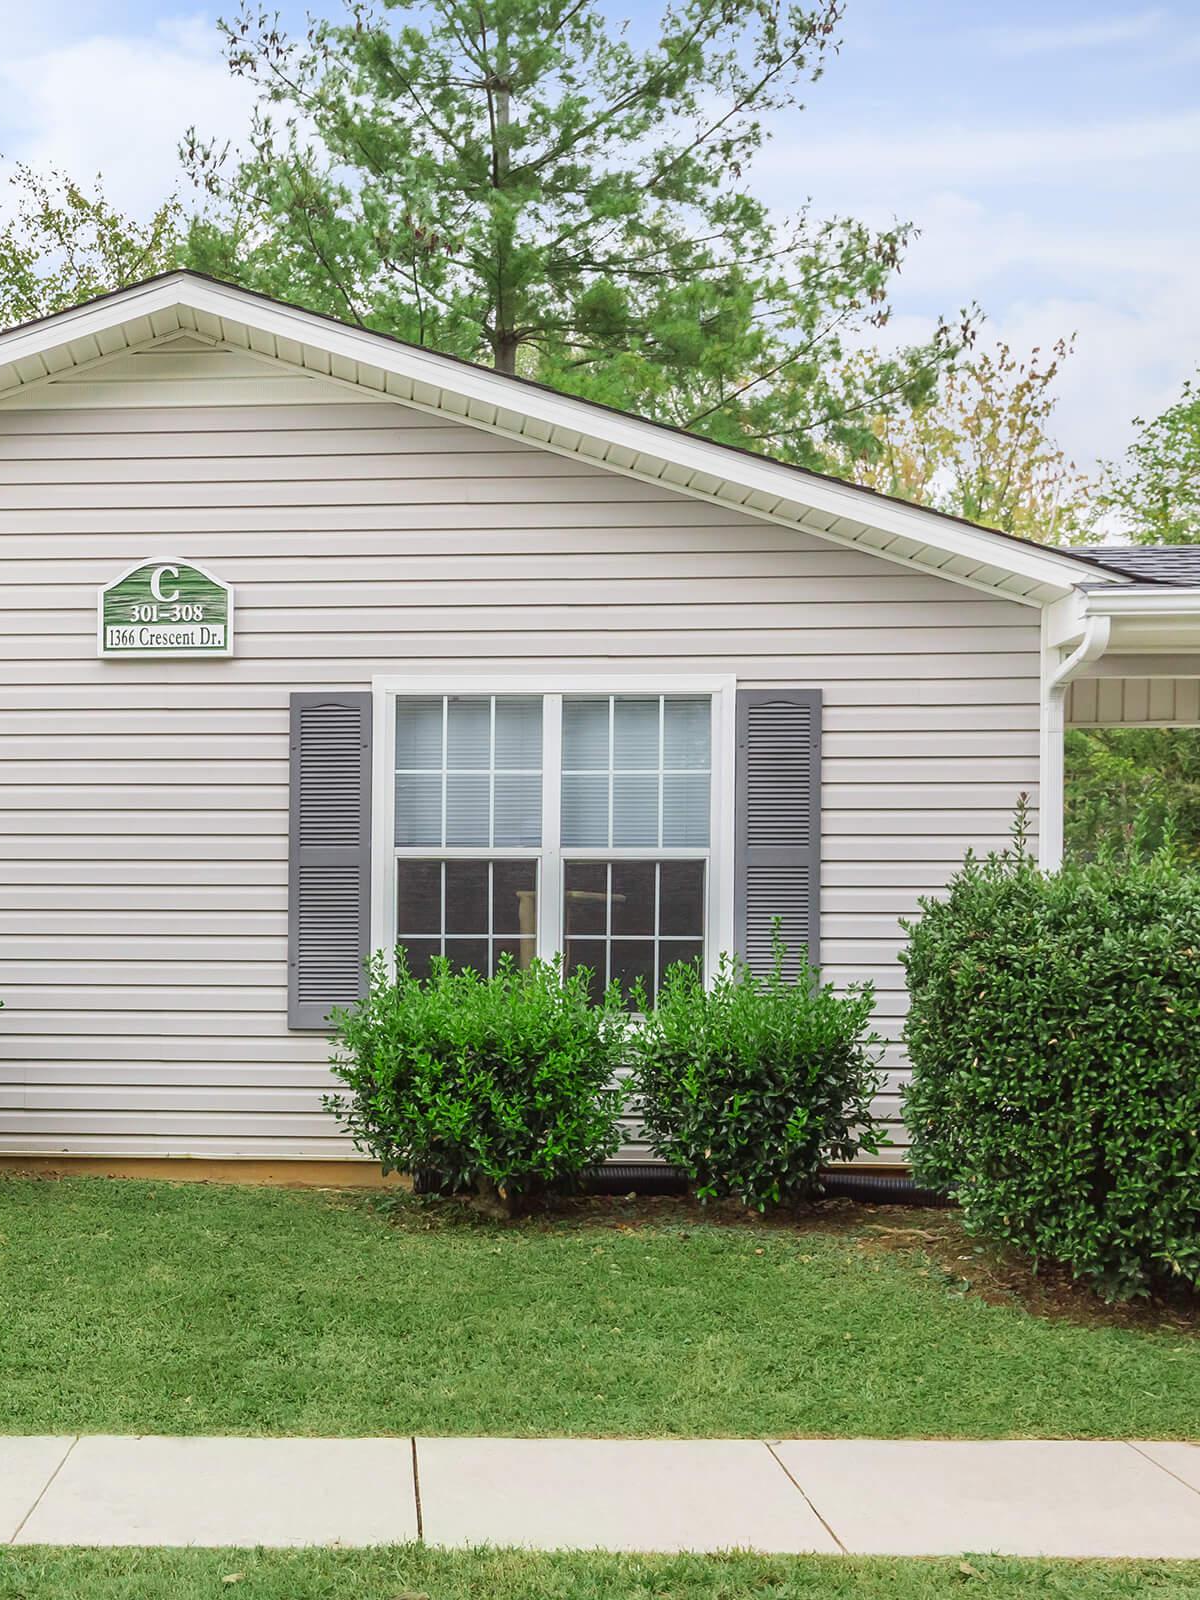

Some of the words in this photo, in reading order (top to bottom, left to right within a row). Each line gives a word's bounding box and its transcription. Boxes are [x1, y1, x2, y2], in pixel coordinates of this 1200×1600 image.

[150, 565, 180, 602] C
[110, 629, 135, 646] 1366
[139, 627, 195, 646] Crescent
[200, 627, 221, 645] Dr.
